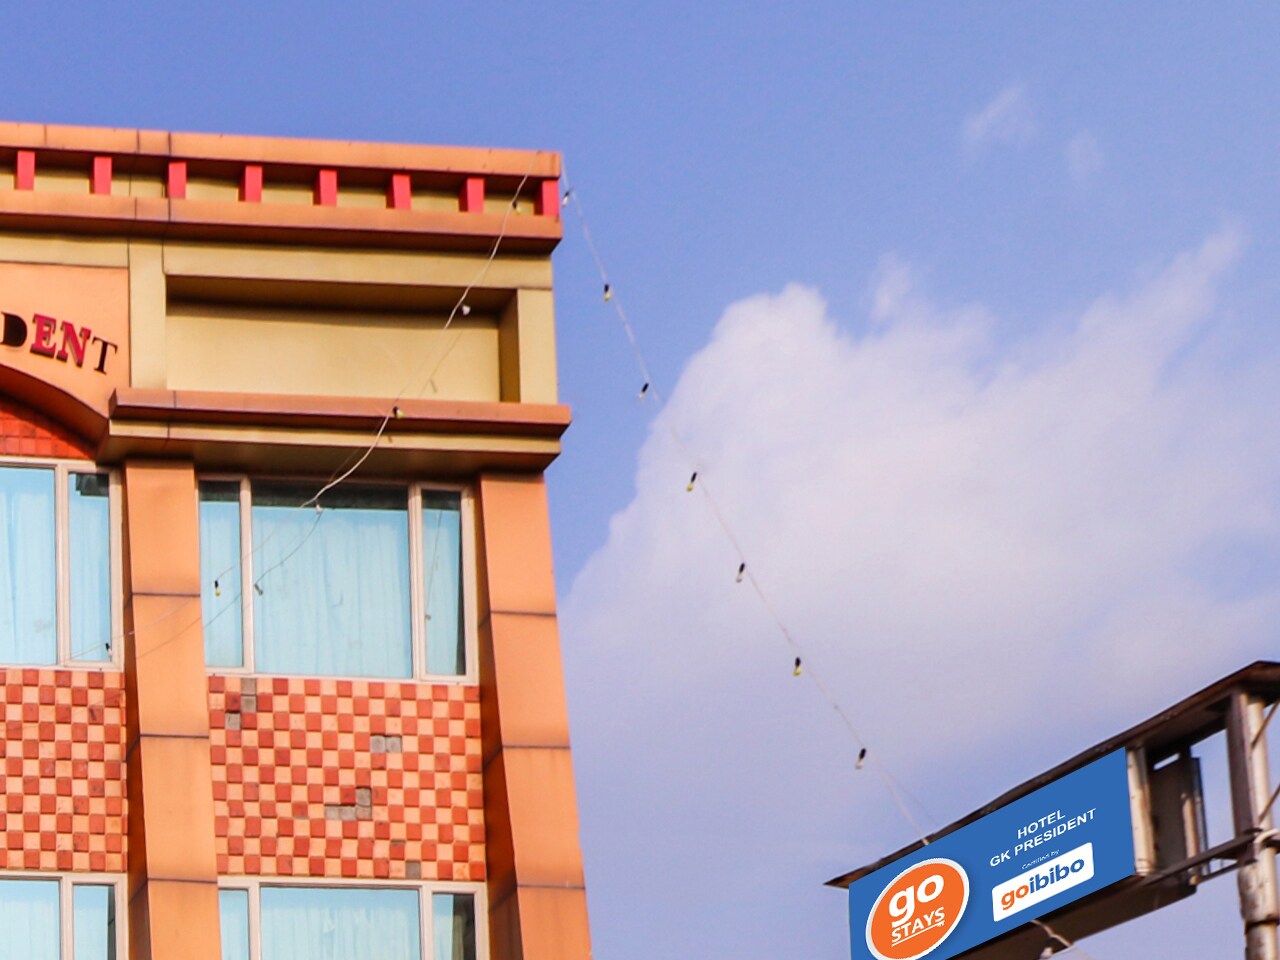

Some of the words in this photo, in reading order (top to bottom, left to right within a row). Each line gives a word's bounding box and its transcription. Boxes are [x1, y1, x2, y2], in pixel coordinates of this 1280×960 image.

[989, 849, 1011, 868] GK
[1014, 807, 1097, 857] PRESIDENT
[1017, 809, 1067, 840] HOTEL
[888, 874, 945, 928] go
[1000, 857, 1085, 911] goibibo
[891, 906, 946, 944] STAYS
